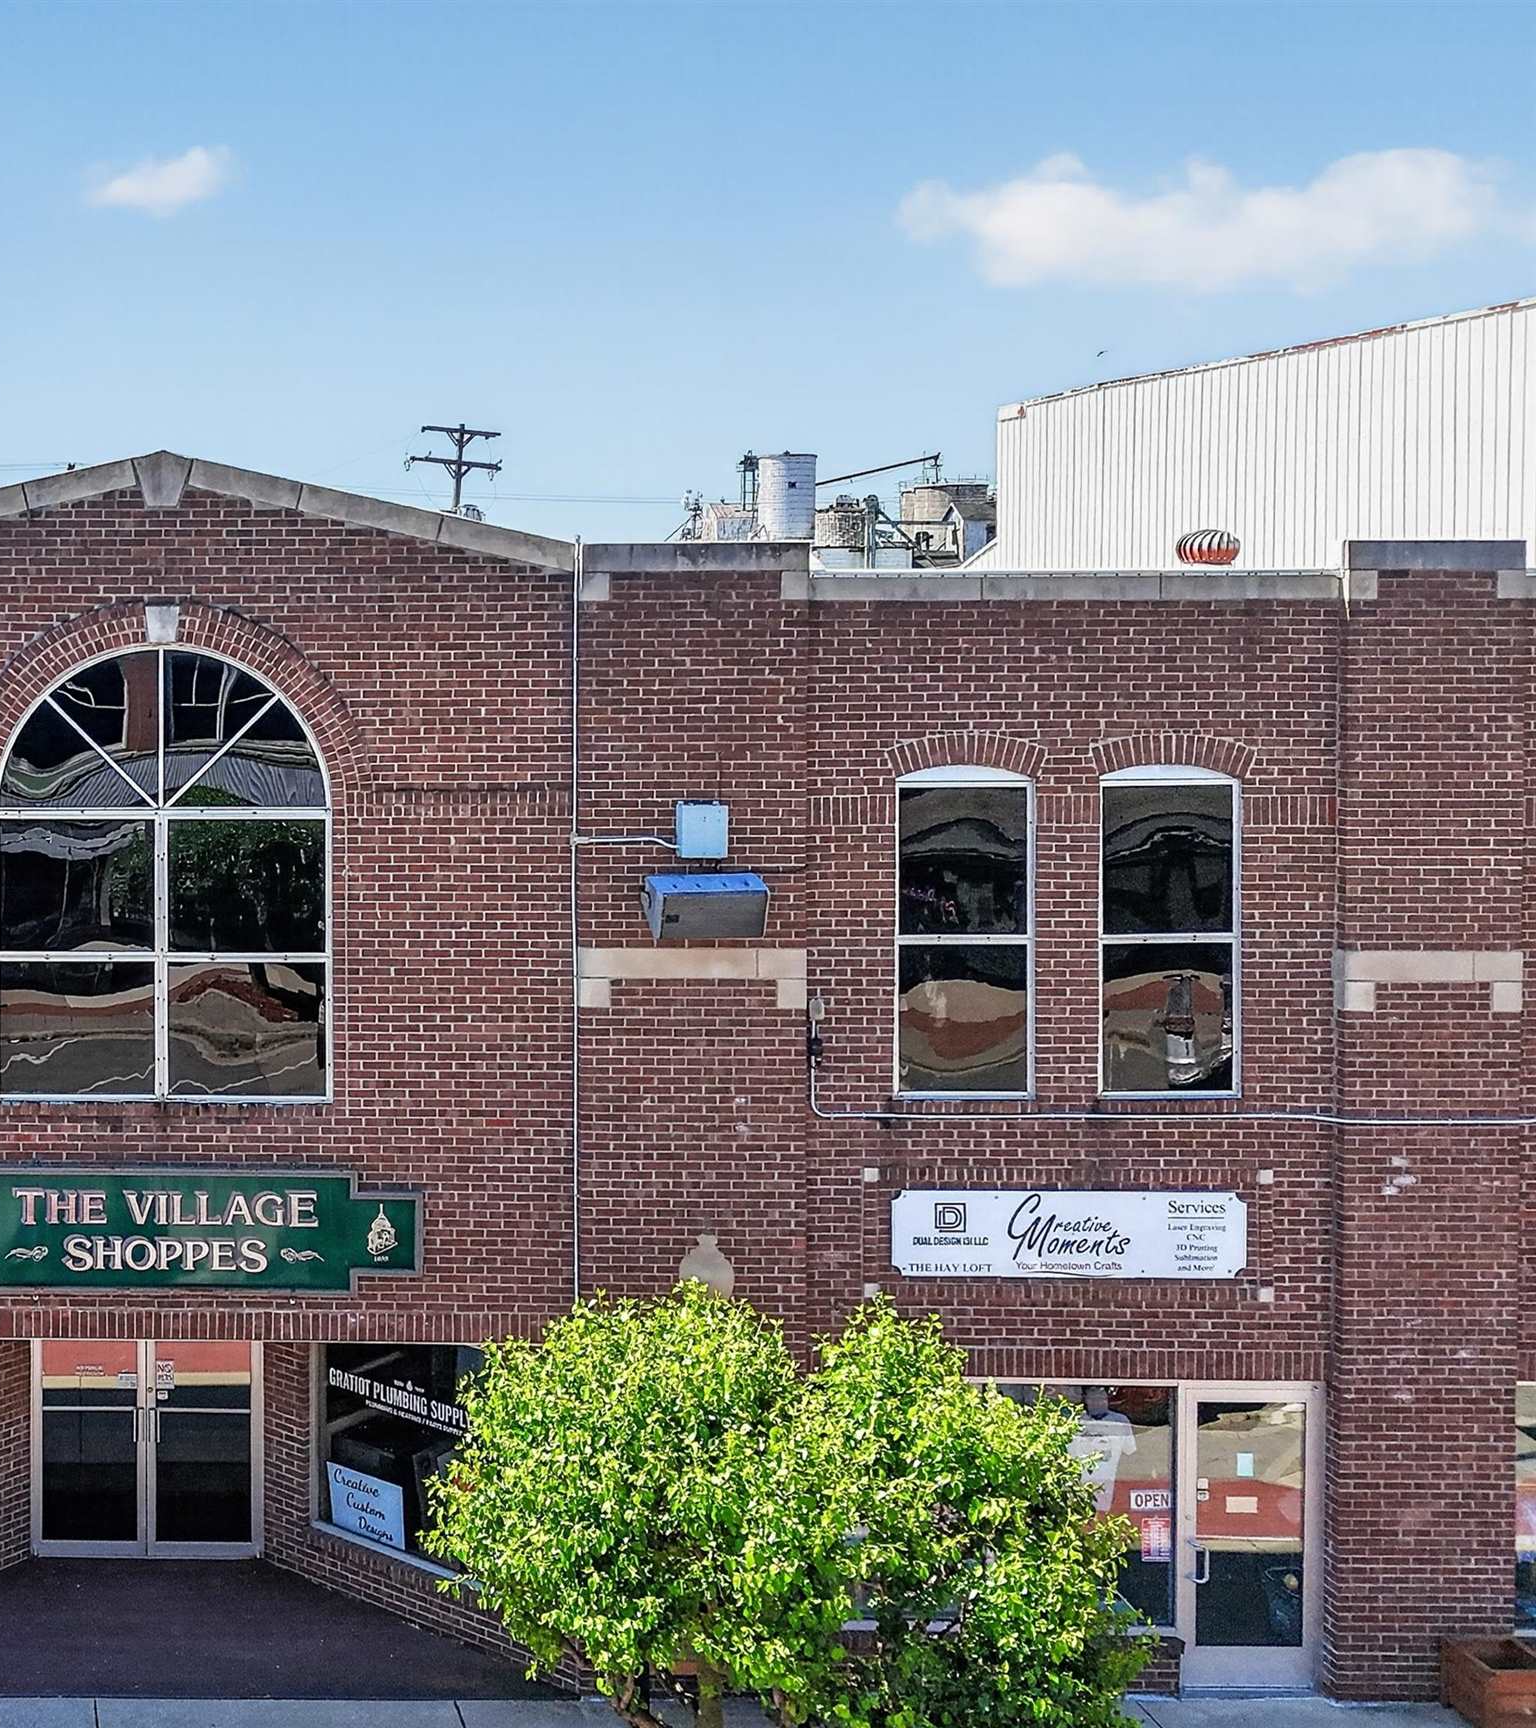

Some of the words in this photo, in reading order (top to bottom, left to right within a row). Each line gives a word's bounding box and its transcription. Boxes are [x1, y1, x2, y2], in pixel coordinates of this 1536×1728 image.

[12, 1187, 108, 1227] THE
[122, 1188, 320, 1229] VILLAGE
[1007, 1193, 1112, 1240] Creative
[1168, 1199, 1226, 1214] Services
[934, 1236, 961, 1246] DESIGN
[974, 1236, 989, 1246] LLC
[1011, 1213, 1132, 1261] Moments
[1186, 1233, 1206, 1241] CNC
[63, 1234, 270, 1275] SHOPPES
[908, 1263, 932, 1273] THE
[935, 1263, 960, 1273] HAY
[962, 1263, 992, 1273] LOFT
[1016, 1261, 1037, 1271] Your
[1040, 1261, 1091, 1271] Hometown
[1094, 1261, 1123, 1271] Crafts
[158, 1363, 173, 1374] NO
[329, 1367, 371, 1397] GRATIOT
[373, 1381, 428, 1416] PLUMBING
[334, 1467, 381, 1498] Creative
[346, 1491, 386, 1521] Custom
[1135, 1493, 1170, 1508] OPEN
[358, 1515, 394, 1543] Designs
